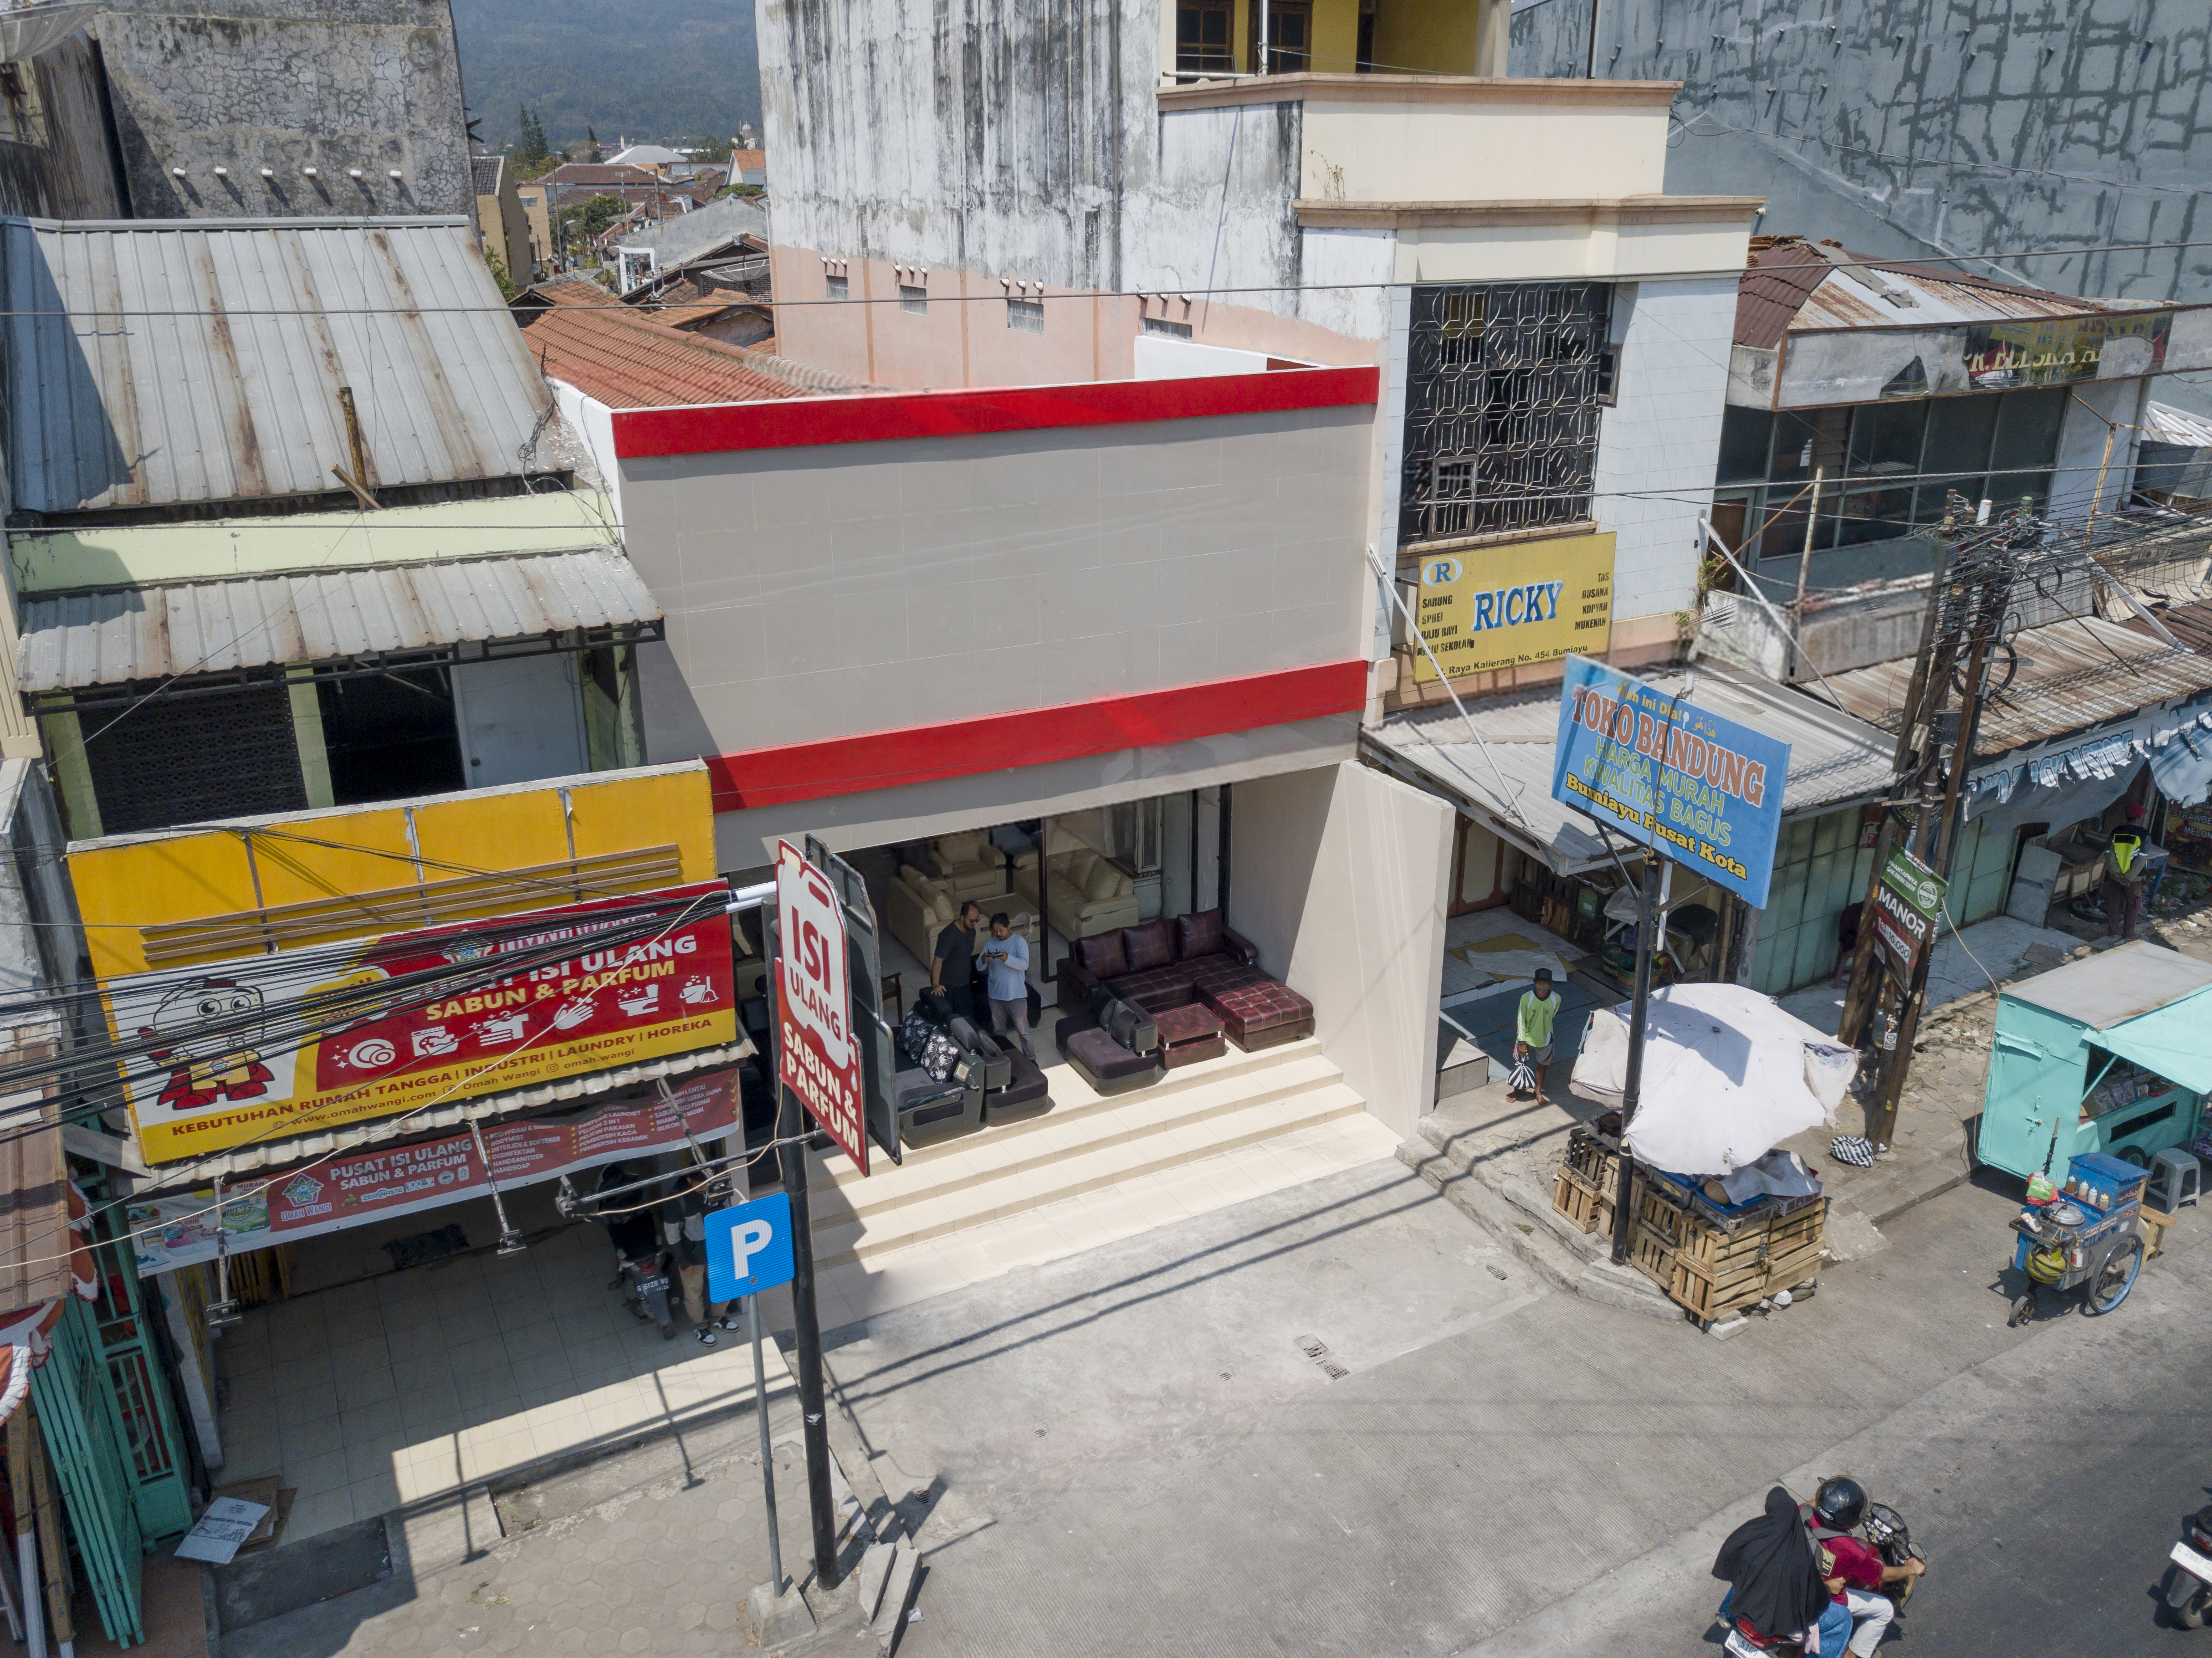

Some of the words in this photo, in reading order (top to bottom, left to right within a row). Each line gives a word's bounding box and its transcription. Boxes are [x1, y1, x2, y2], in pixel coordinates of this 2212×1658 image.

[1435, 562, 1451, 582] R
[1598, 572, 1609, 582] TAS
[1422, 595, 1452, 608] SARUNG
[1582, 587, 1608, 600] BUSANA
[1471, 580, 1563, 631] RICKY
[1582, 602, 1607, 615] KOPYAH
[1422, 612, 1443, 625] SPREI
[1575, 617, 1606, 631] MUKENAH
[1421, 628, 1440, 640] BAJU
[1442, 625, 1457, 637] BAYI
[1420, 644, 1438, 656] BJU
[1441, 638, 1472, 653] SEKOLAH
[1449, 666, 1471, 675] Raya
[1473, 657, 1515, 670] Kalierang
[1535, 650, 1550, 659] 454
[1553, 645, 1588, 657] Bumiayu
[1618, 687, 1638, 705] Nah
[1642, 694, 1657, 712] ini
[1572, 690, 1634, 746] TOKO
[1635, 711, 1766, 808] BANDUNG
[1596, 736, 1652, 782] HARGA
[1658, 765, 1725, 817] MURAH
[1584, 755, 1665, 813] KWALITAS
[1670, 798, 1732, 847] BAGUS
[1566, 772, 1640, 825] Bumiayu
[1643, 812, 1696, 853] Pusat
[1698, 841, 1747, 881] Kota
[1878, 887, 1926, 940] MANOR
[581, 935, 697, 971] ULANG
[792, 905, 831, 996] ISI
[426, 988, 526, 1021] SABUN
[535, 984, 555, 999] &
[562, 960, 675, 995] PARFUM
[790, 966, 841, 1041] ULANG
[172, 1104, 294, 1136] KEBUTUHAN
[300, 1089, 371, 1111] RUMAH
[375, 1072, 452, 1095] TANGGA
[465, 1052, 545, 1077] INDUSTRI
[557, 1033, 636, 1058] LAUNDRY
[647, 1019, 713, 1039] HOREKA
[784, 1021, 841, 1105] SABUN
[844, 1089, 858, 1125] &
[291, 1091, 436, 1125] www.omahwangi.com
[463, 1077, 499, 1091] Omah
[502, 1067, 540, 1084] Wangi
[563, 1047, 636, 1069] omah.wangi
[685, 1084, 705, 1094] LANTAI
[705, 1087, 722, 1096] GUNA
[687, 1107, 704, 1117] MOBIL
[692, 1098, 710, 1108] PIRING
[786, 1050, 859, 1157] PARFUM
[578, 1113, 608, 1129] PARFUME
[579, 1123, 602, 1135] PELICIN
[657, 1122, 680, 1131] SILIKON
[490, 1126, 526, 1139] BODYFOAM
[490, 1134, 524, 1147] BODYMIST
[580, 1129, 603, 1142] PELICIN
[603, 1123, 636, 1132] PAKAIAN
[580, 1133, 616, 1147] PEMBERSIH
[491, 1142, 523, 1153] DETERJEN
[529, 1136, 560, 1147] SOFTENER
[580, 1139, 617, 1153] PEMBERSIH
[618, 1134, 649, 1143] KERAMIK
[330, 1157, 386, 1180] PUSAT
[391, 1153, 411, 1167] ISI
[415, 1139, 472, 1160] ULANG
[492, 1148, 535, 1160] DESINFEKTAN
[493, 1154, 544, 1167] HANDSANITIZER
[340, 1170, 390, 1190] SABUN
[394, 1168, 404, 1178] &
[408, 1154, 467, 1175] PARFUM
[494, 1163, 530, 1174] HANDSOAP
[281, 1209, 305, 1221] OMAH
[305, 1202, 332, 1216] WANGI
[731, 1219, 772, 1280] P
